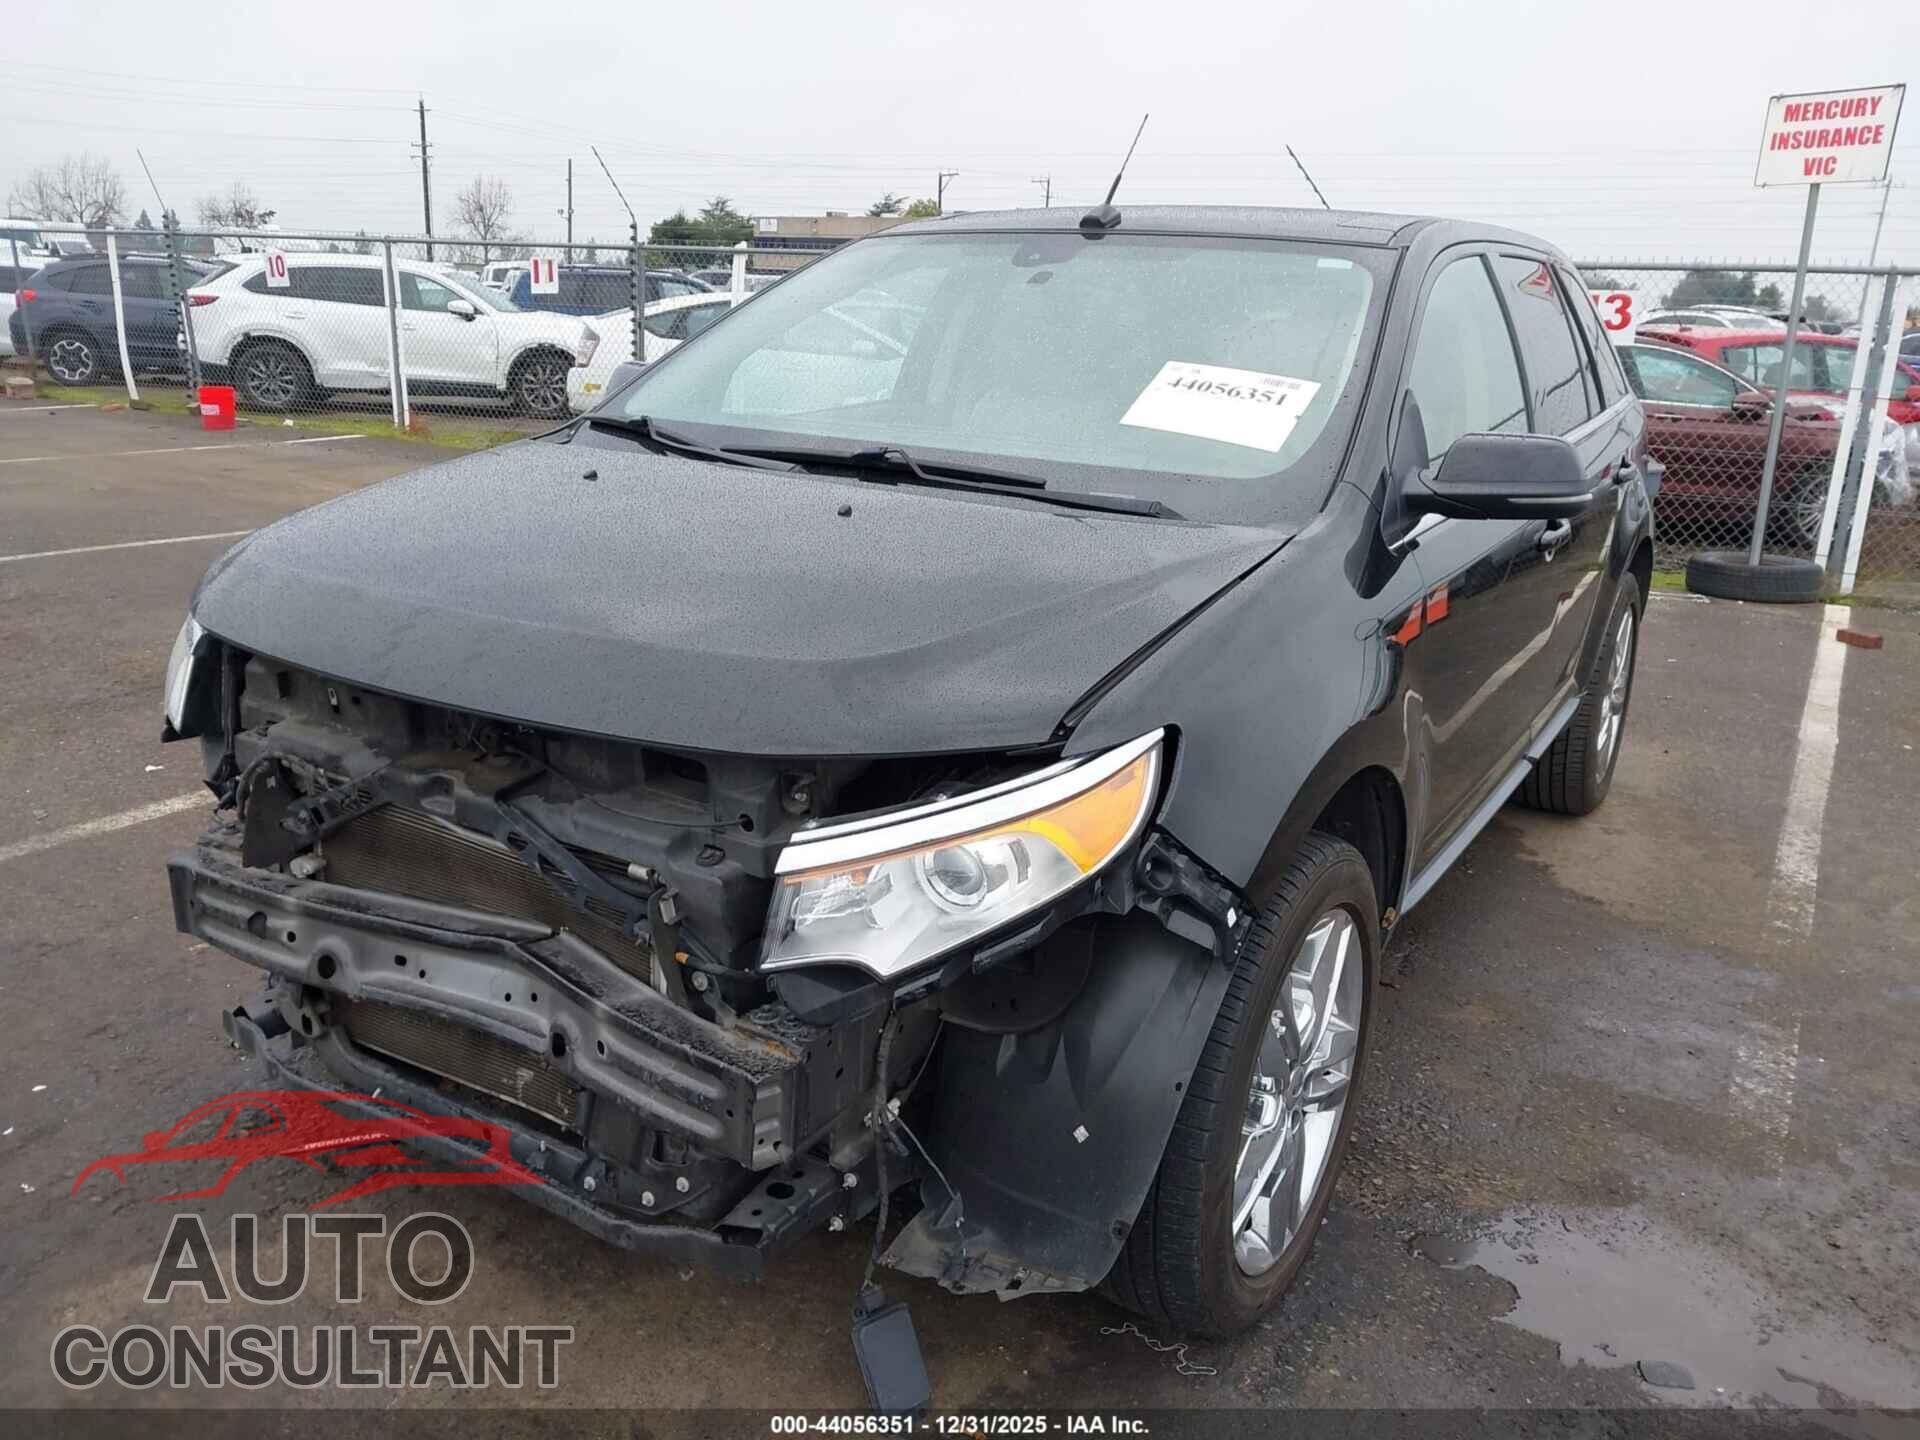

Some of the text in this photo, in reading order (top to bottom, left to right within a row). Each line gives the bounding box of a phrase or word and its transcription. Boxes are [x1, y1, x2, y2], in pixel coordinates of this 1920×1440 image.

[1783, 96, 1883, 123] MERCURY
[1770, 124, 1885, 150] INSURANCE
[1803, 155, 1838, 177] VIC
[268, 254, 285, 278] 10
[532, 259, 554, 284] 11
[1592, 293, 1633, 331] 3
[1167, 376, 1288, 406] 44056351
